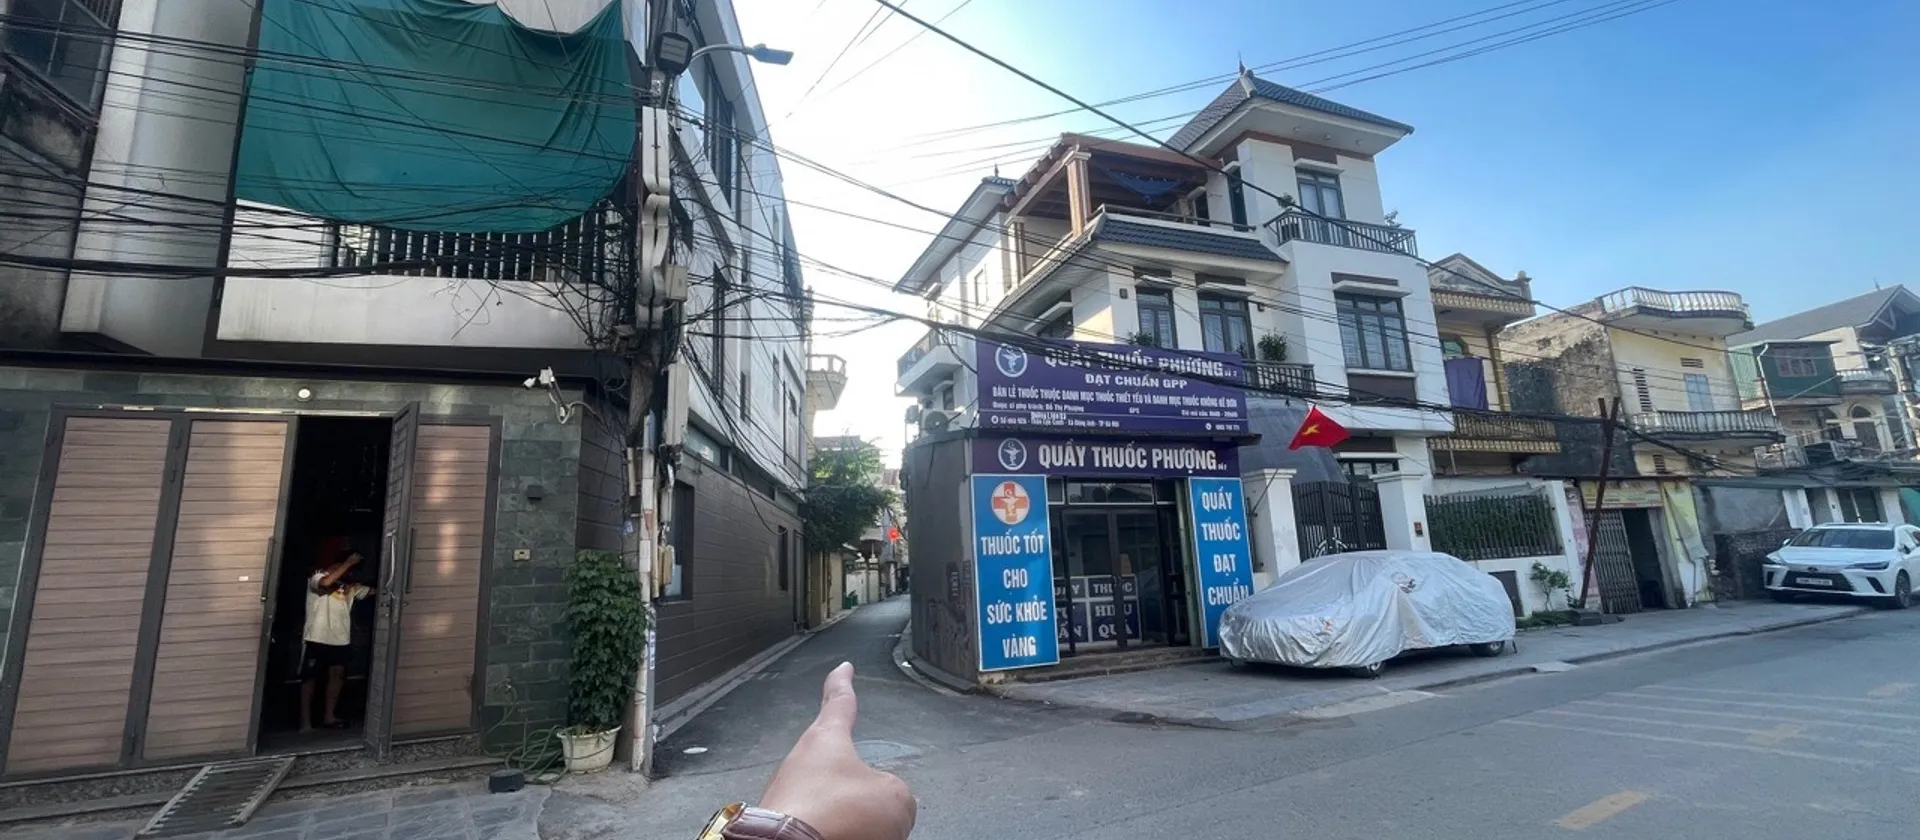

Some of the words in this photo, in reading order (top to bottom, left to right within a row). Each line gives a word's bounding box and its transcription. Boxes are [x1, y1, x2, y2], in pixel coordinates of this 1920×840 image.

[1084, 373, 1111, 387] ĐẠT
[1162, 379, 1188, 389] GPP
[1091, 440, 1147, 468] THUỐC
[1152, 448, 1217, 473] PHƯỢNG
[1201, 516, 1241, 541] THUỐC
[981, 528, 1021, 555] THUỐC
[1023, 528, 1044, 554] TỐT
[1213, 554, 1236, 577] ĐẠT
[1003, 568, 1028, 589] CHO
[986, 600, 1012, 625] SỨC
